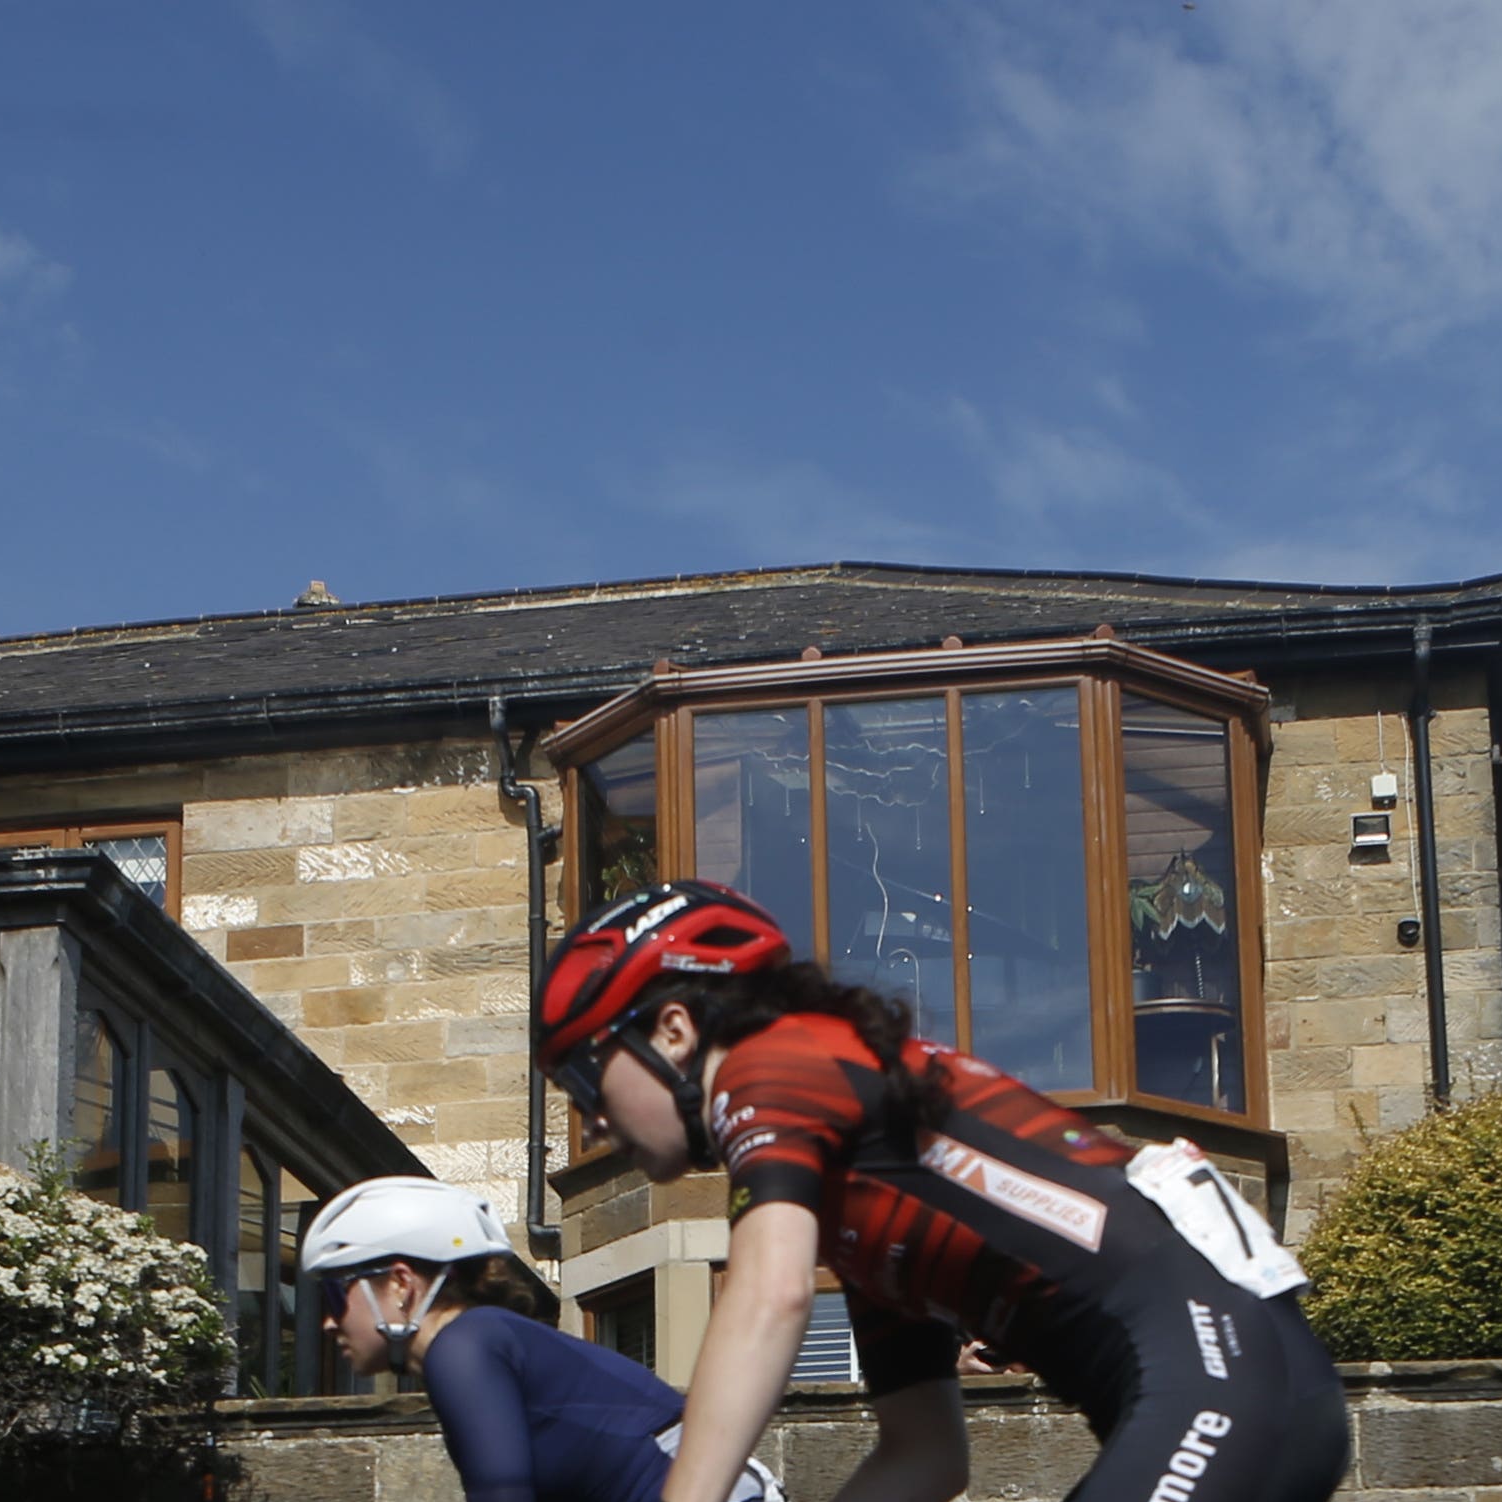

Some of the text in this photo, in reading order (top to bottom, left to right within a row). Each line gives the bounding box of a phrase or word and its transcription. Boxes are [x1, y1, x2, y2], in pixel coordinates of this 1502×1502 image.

[625, 895, 689, 944] LAZER
[994, 1179, 1091, 1227] SUPPLIES
[1187, 1299, 1230, 1380] GIANT
